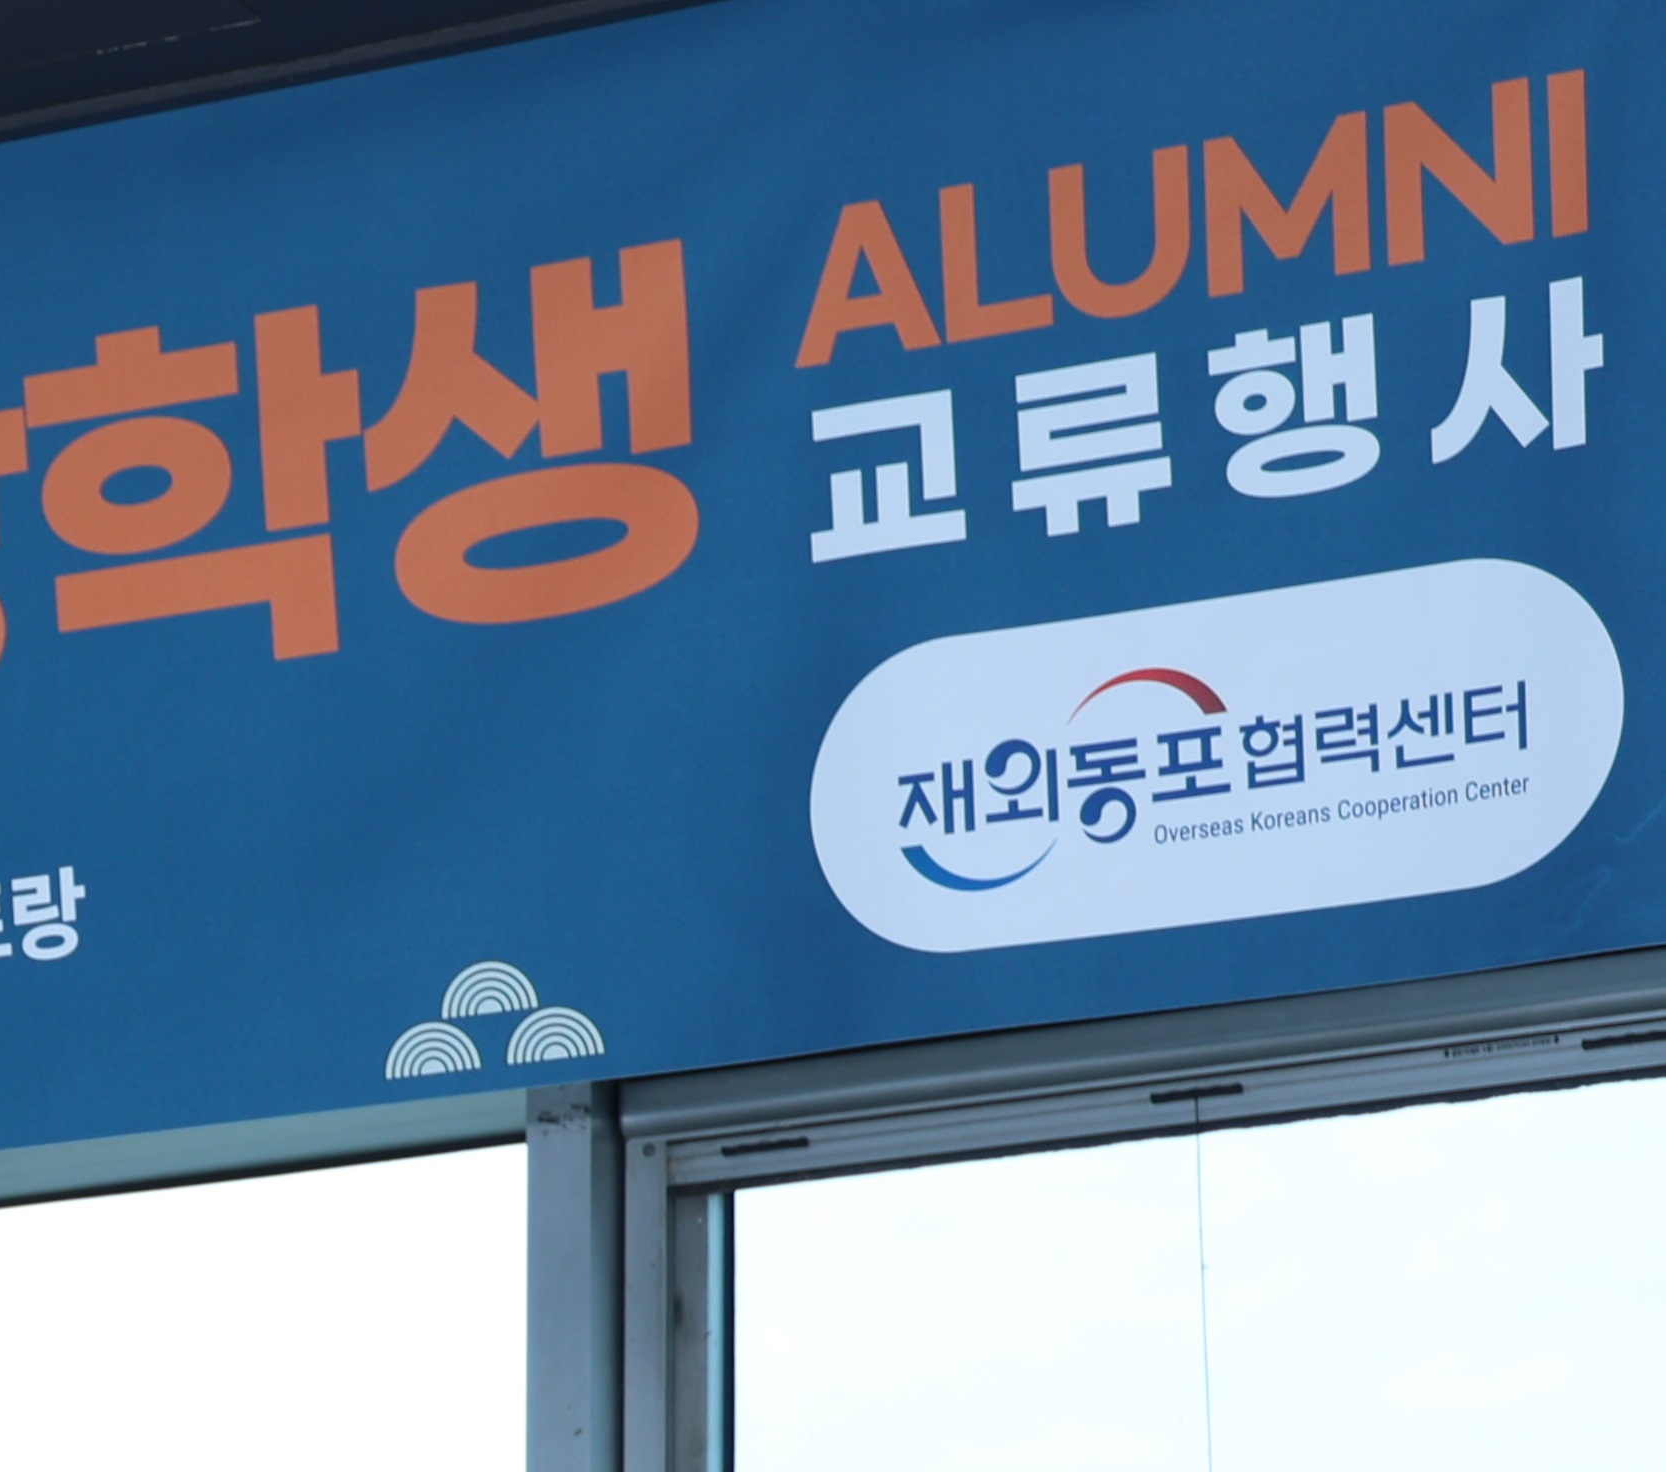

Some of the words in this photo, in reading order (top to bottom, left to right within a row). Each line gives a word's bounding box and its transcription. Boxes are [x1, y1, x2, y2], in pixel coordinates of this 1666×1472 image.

[796, 69, 1589, 368] ALUMNI
[810, 276, 1604, 563] 교류행사
[898, 680, 1528, 844] 재외동포협력센터
[1154, 818, 1244, 845] Overseas
[1250, 806, 1331, 831] Koreans
[1337, 788, 1459, 820] Cooperation
[1465, 777, 1530, 802] Center
